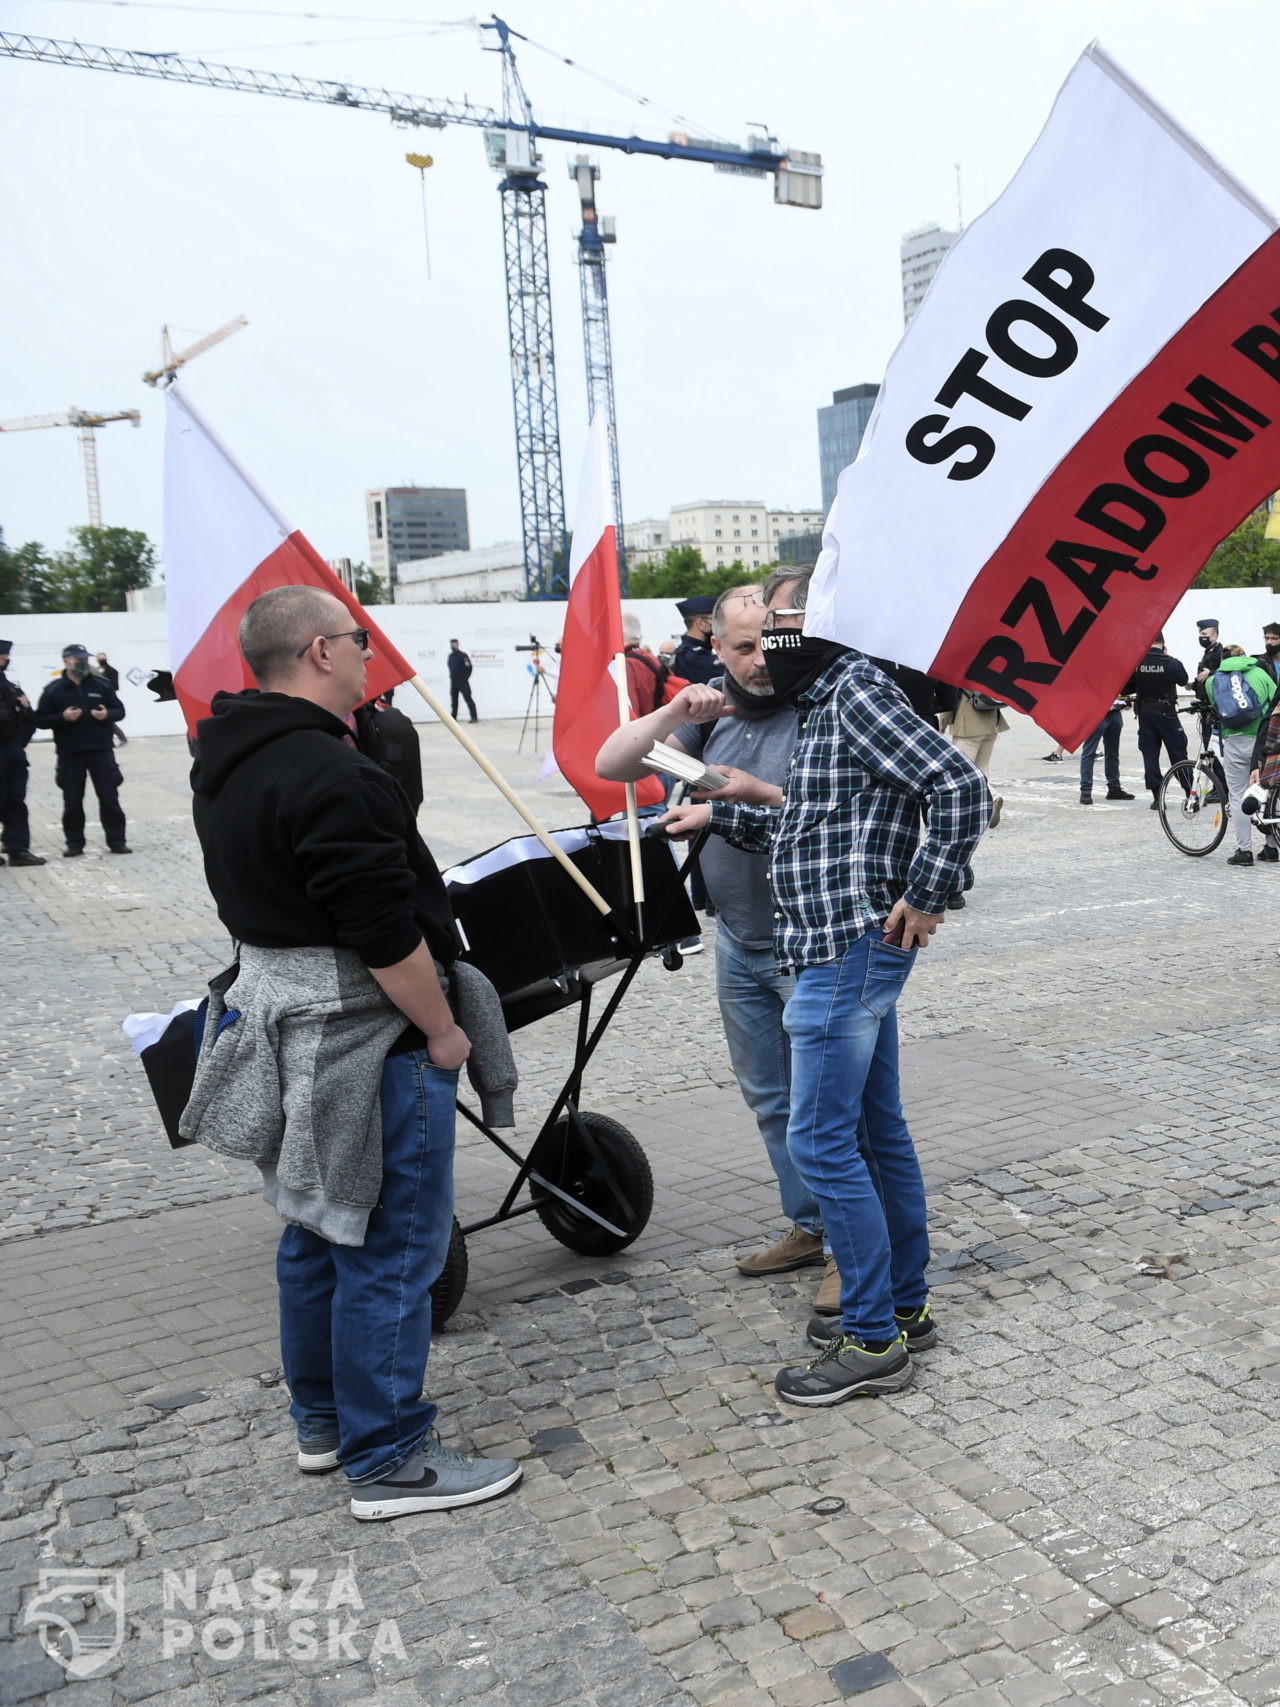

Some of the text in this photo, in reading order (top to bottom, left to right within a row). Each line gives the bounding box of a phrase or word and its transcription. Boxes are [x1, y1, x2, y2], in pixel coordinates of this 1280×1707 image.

[905, 247, 1110, 482] STOP
[965, 373, 1272, 713] RZĄDOM
[761, 634, 801, 651] OCY!!!
[1136, 665, 1165, 673] OLICJA
[1231, 674, 1248, 709] adidas
